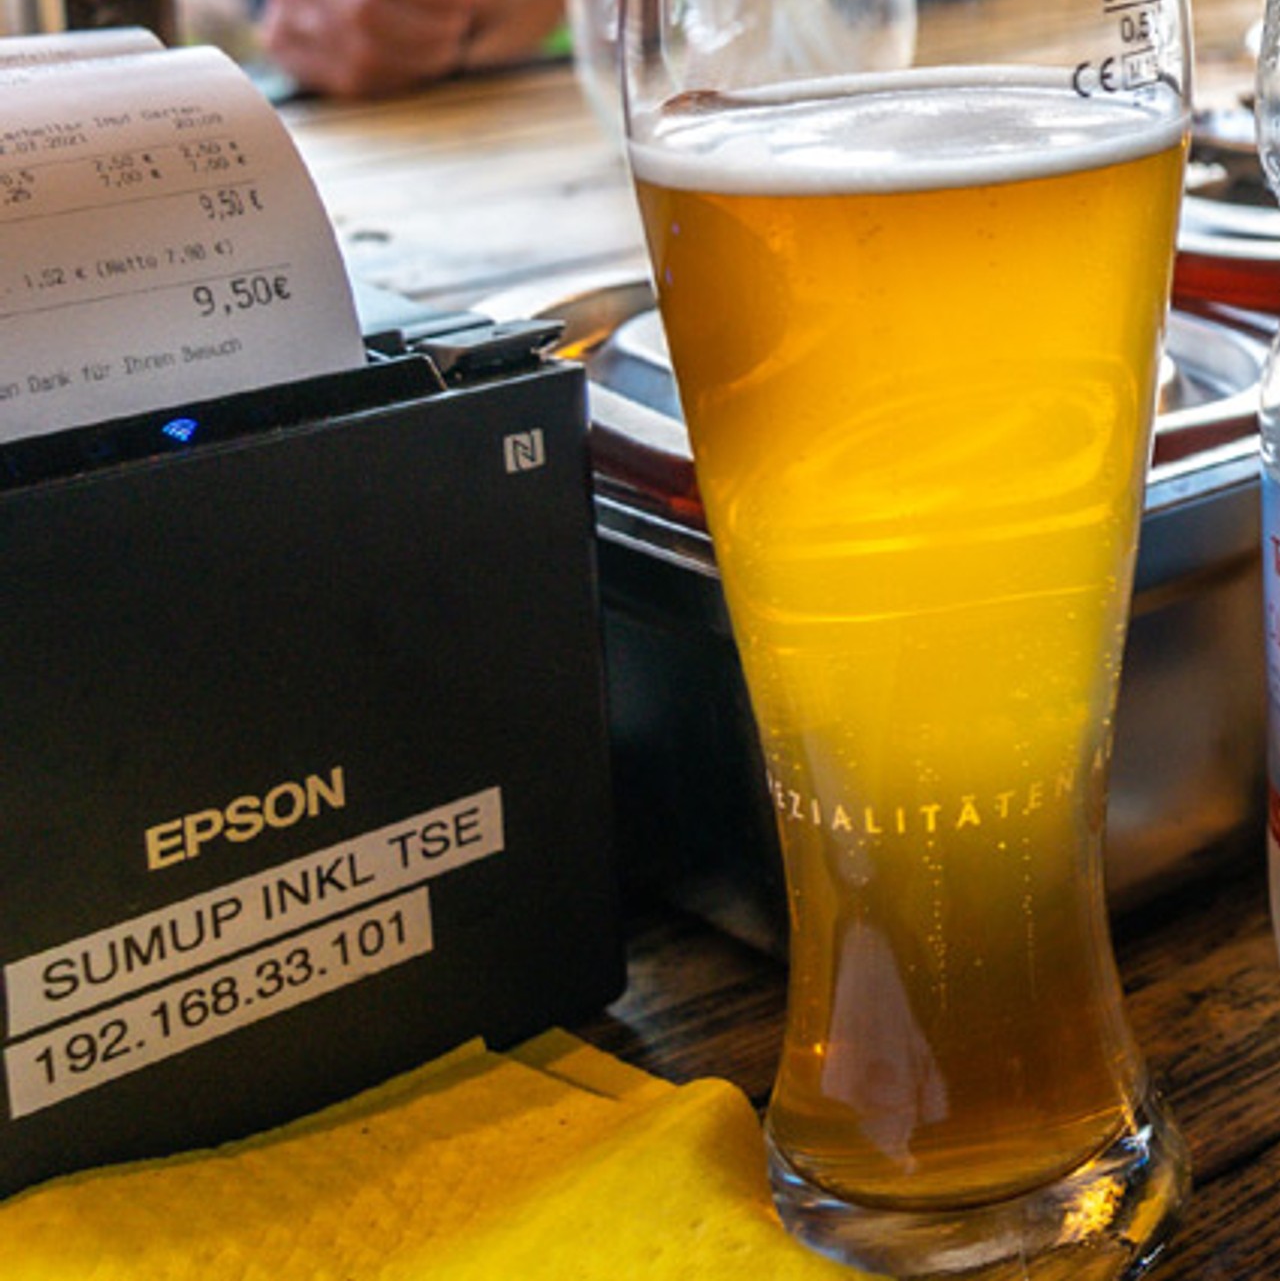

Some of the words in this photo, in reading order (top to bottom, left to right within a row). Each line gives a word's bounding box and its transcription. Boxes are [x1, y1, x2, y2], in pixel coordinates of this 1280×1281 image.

[193, 275, 292, 317] 9,50€
[145, 766, 347, 870] EPSON
[765, 768, 1076, 834] EZIALITÄTEN
[41, 896, 243, 1002] SUMUP
[262, 852, 376, 919] INKL
[388, 807, 483, 868] TSE
[35, 910, 407, 1085] 192.168.33.101
